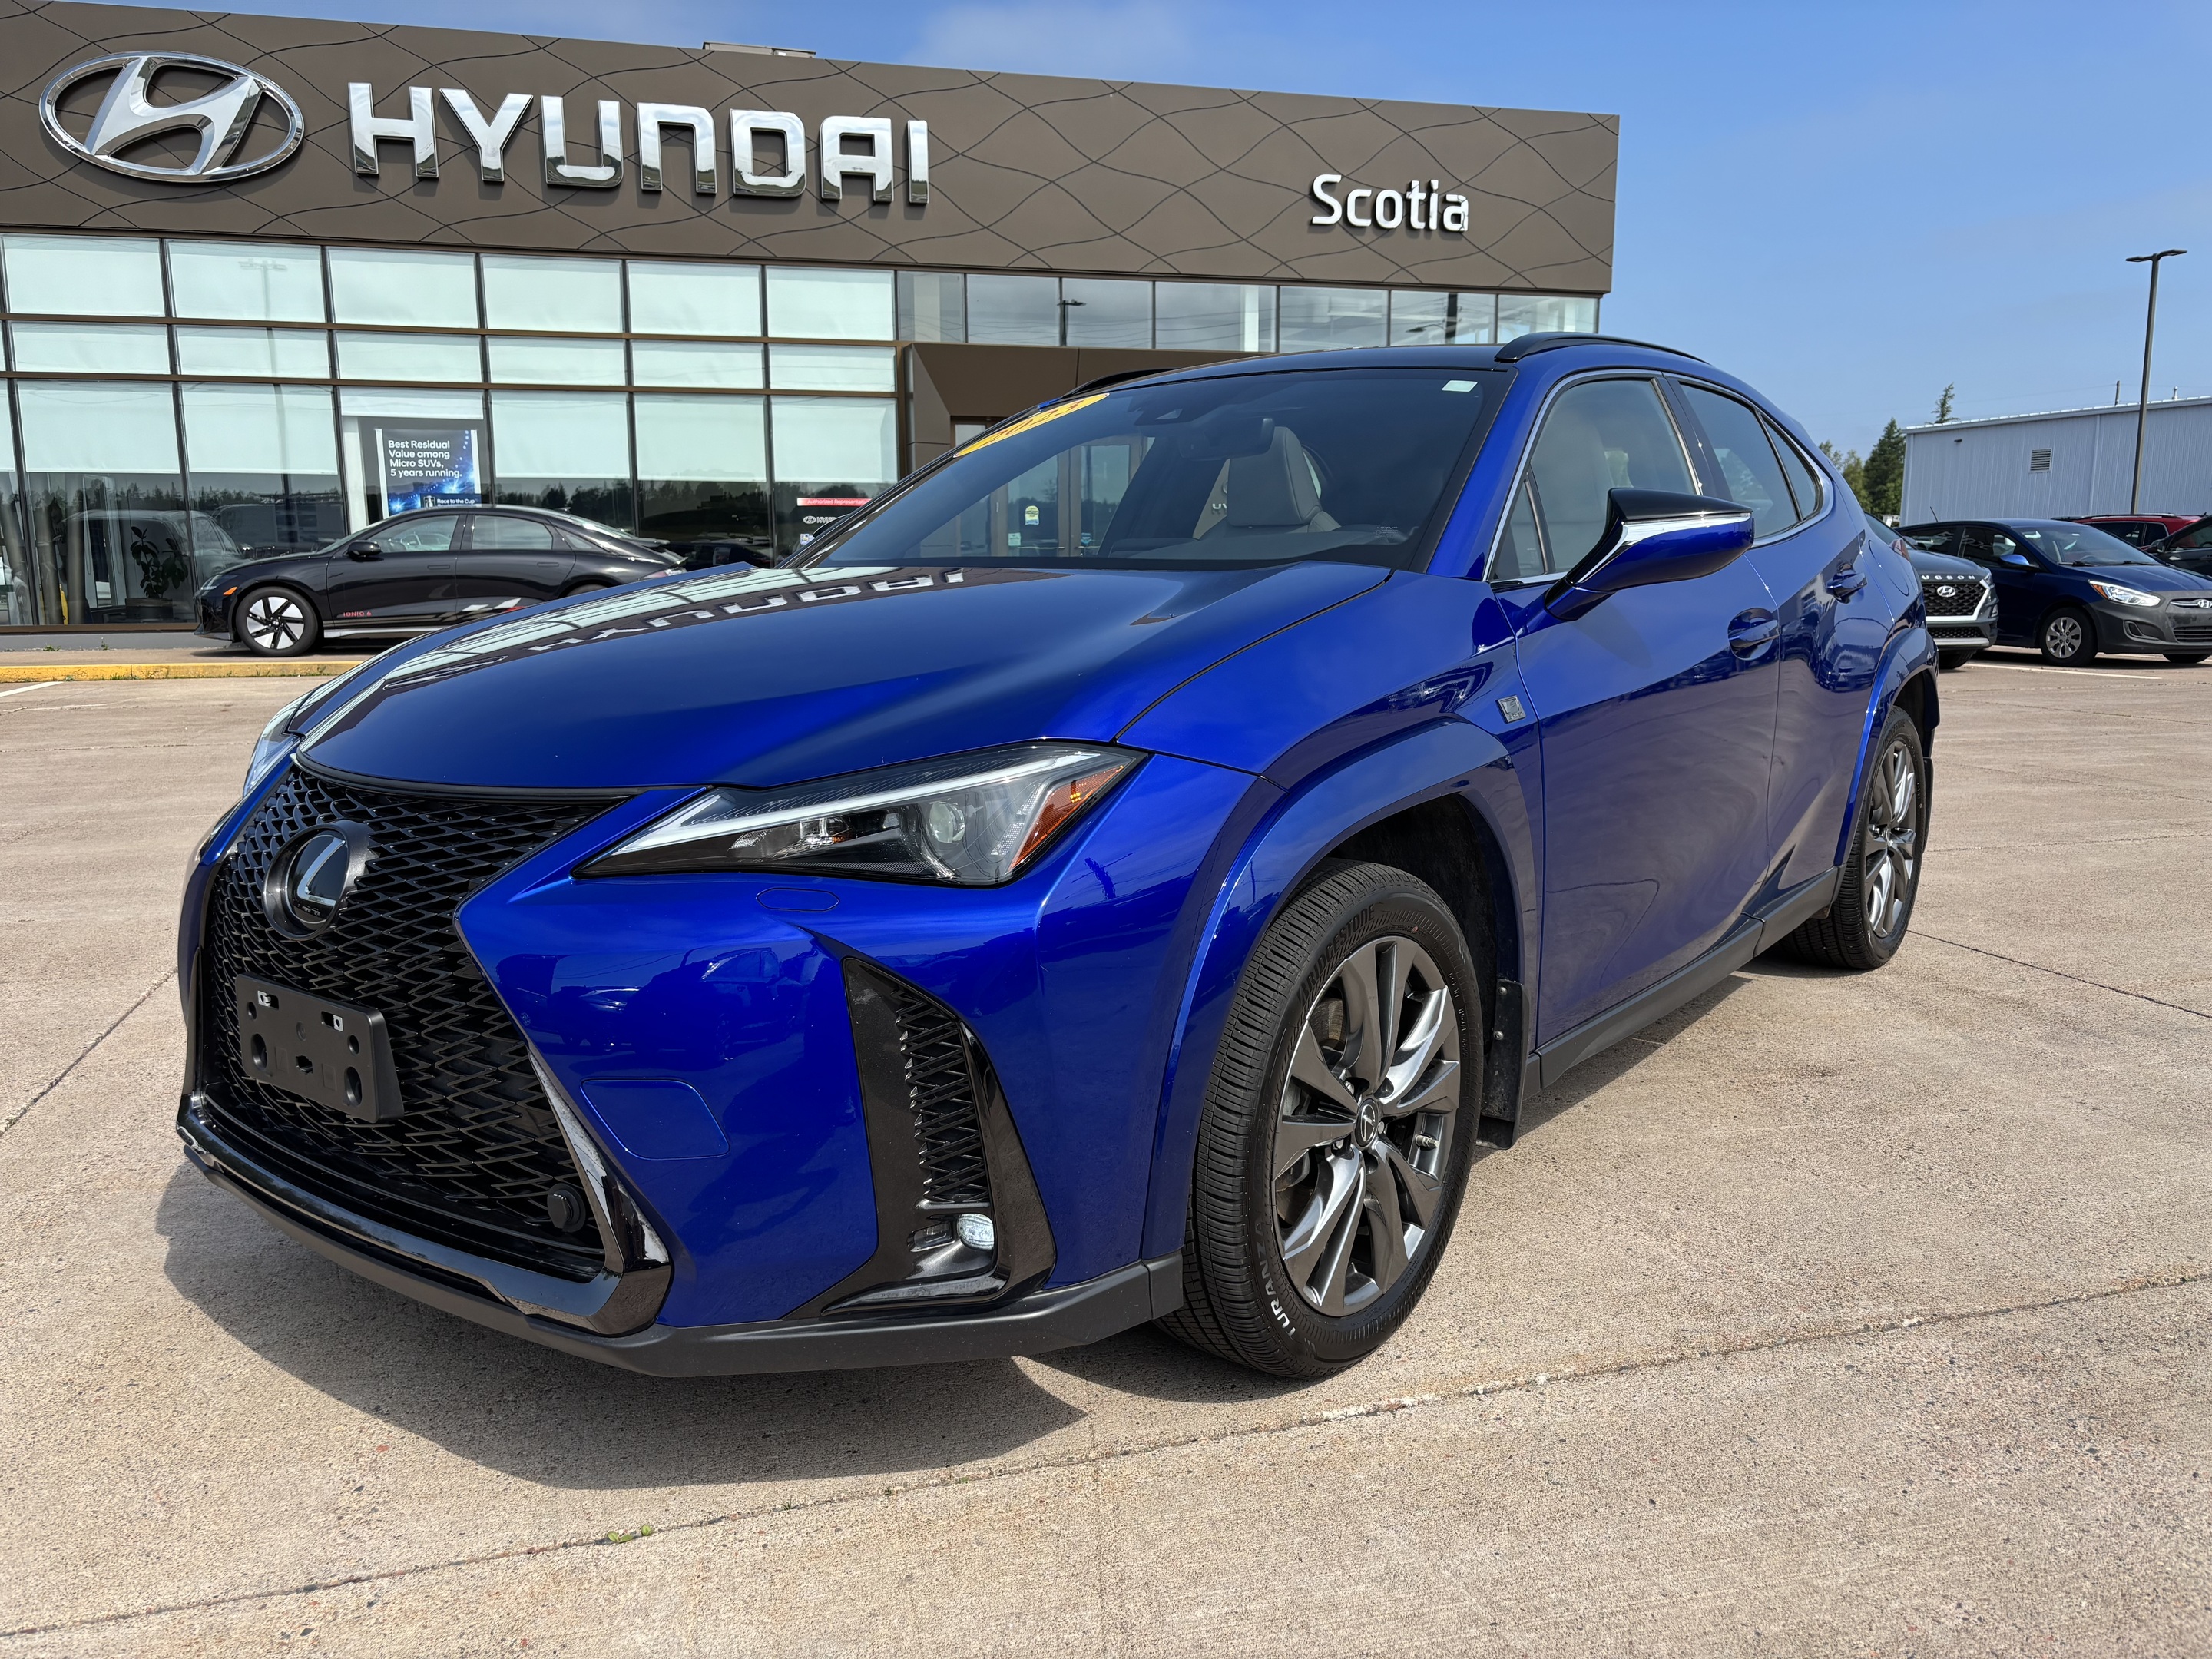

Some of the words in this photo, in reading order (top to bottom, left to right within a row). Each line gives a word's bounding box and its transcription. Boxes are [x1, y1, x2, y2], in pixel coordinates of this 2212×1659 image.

[348, 82, 930, 204] HYUNDAI
[1312, 174, 1469, 232] Scotia
[388, 440, 409, 449] Best
[410, 440, 450, 449] Residual
[389, 449, 416, 458] Value
[416, 451, 450, 460] among
[389, 459, 416, 468] Micro
[417, 459, 444, 469] SUVs,
[390, 469, 396, 477] 5
[398, 470, 424, 478] years
[425, 469, 462, 478] running.
[1300, 902, 1375, 1006] BRIDGESTONE
[1254, 1220, 1296, 1342] TURANZA
